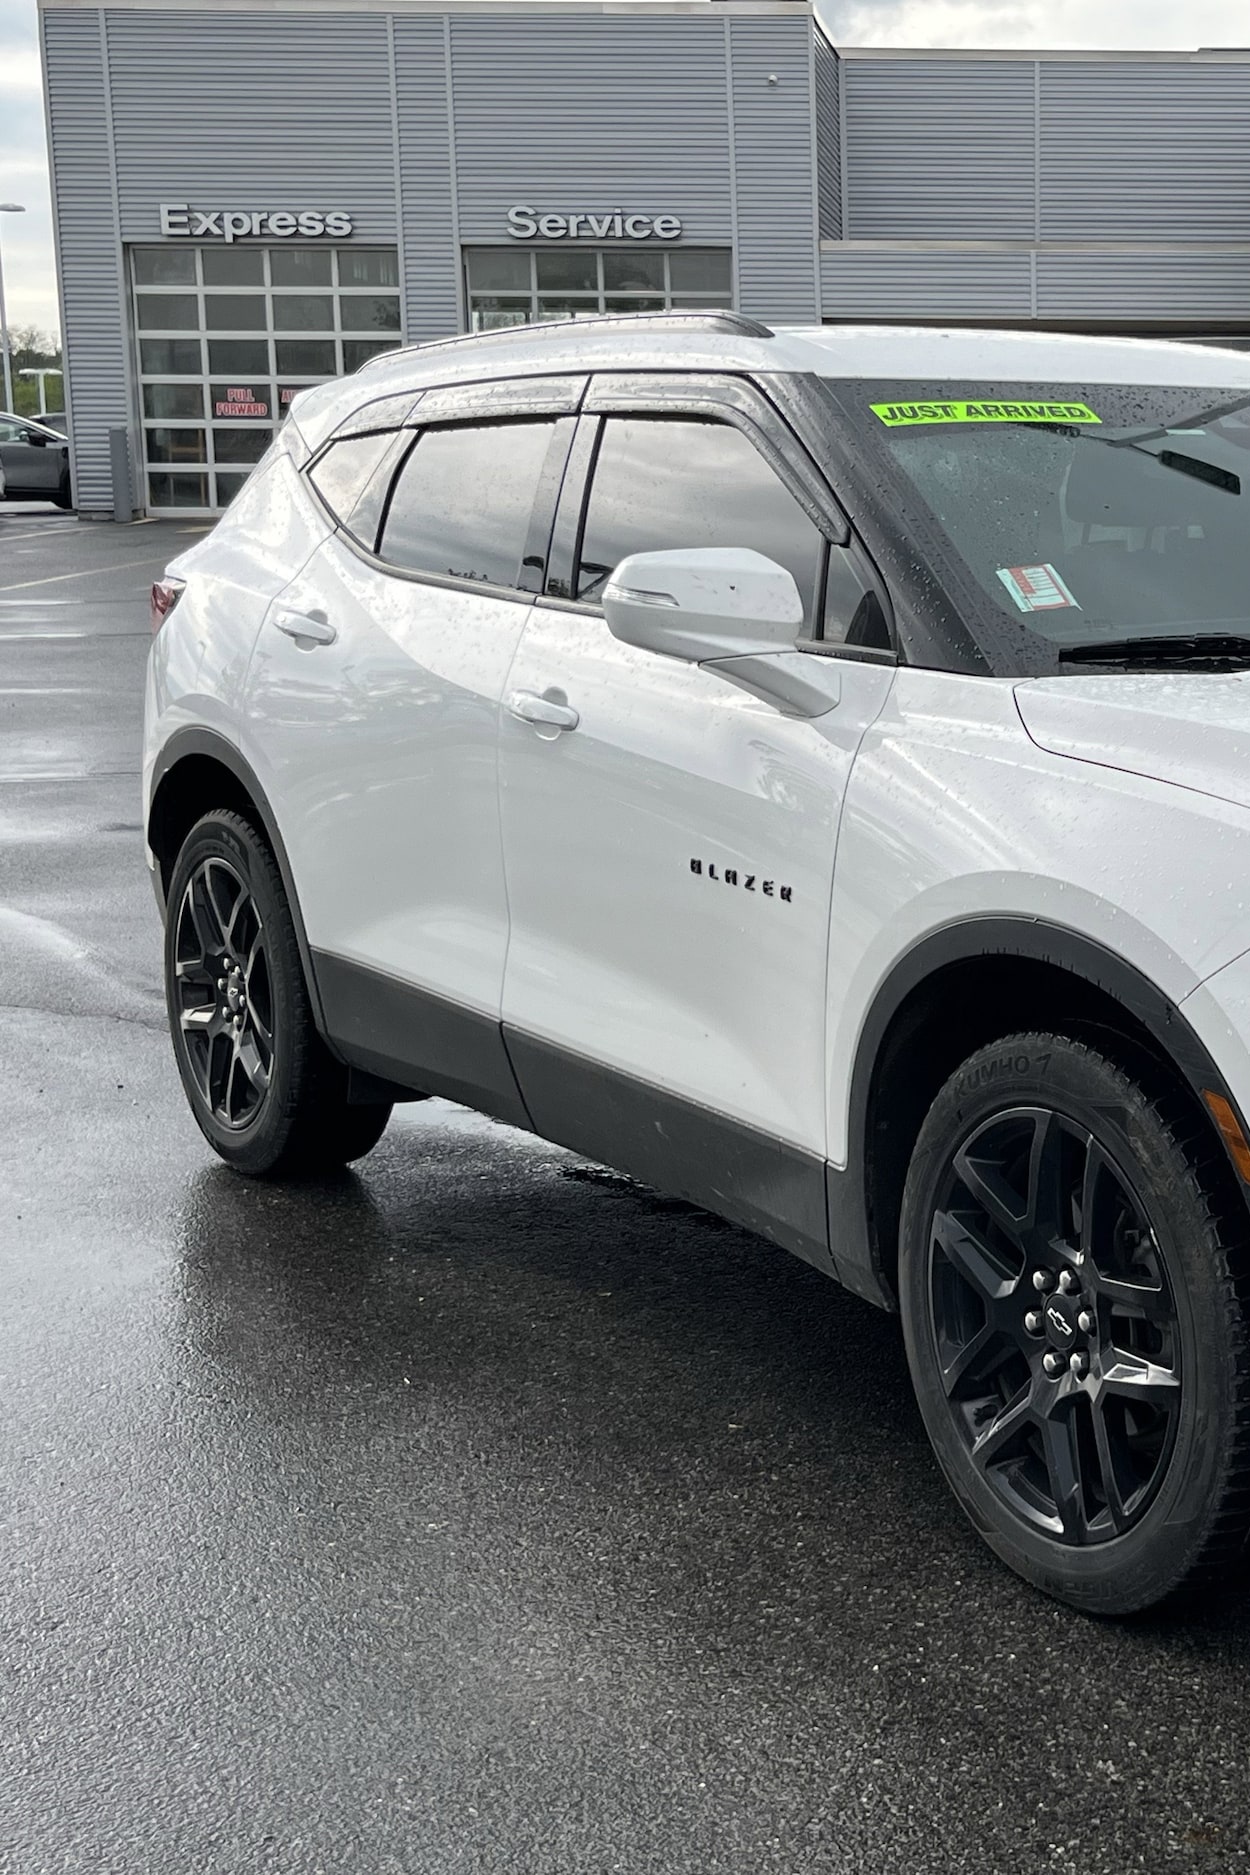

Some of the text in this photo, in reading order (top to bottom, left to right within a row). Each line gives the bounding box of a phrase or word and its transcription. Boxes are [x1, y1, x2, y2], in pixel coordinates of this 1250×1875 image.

[159, 203, 353, 242] Express
[506, 205, 682, 239] Service
[216, 402, 268, 416] FORWARD
[227, 388, 255, 402] PULL
[883, 404, 1092, 422] JUST ARRIVED
[690, 858, 792, 903] BLAZER
[954, 1055, 1030, 1097] KUMHO
